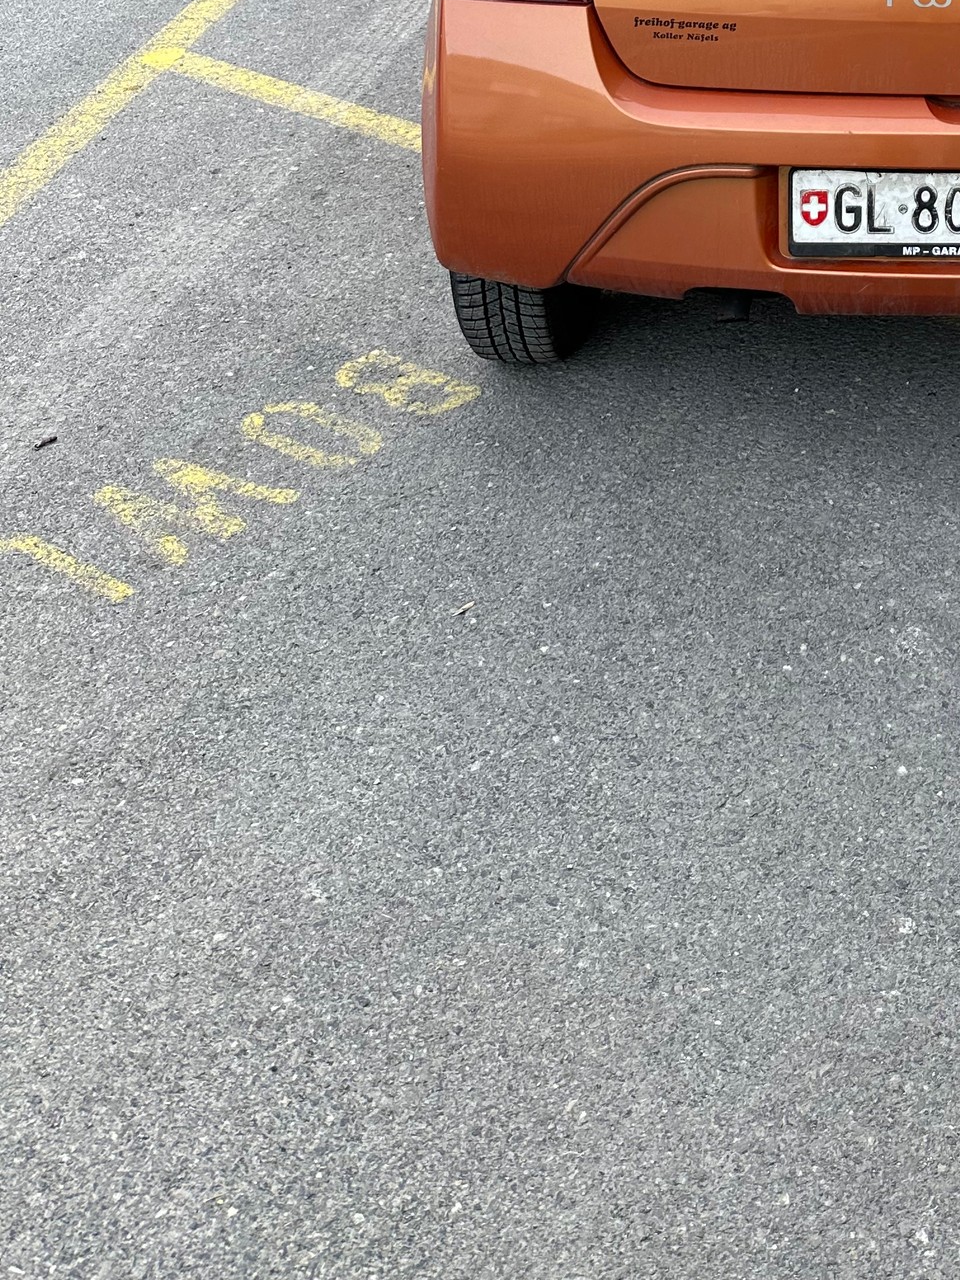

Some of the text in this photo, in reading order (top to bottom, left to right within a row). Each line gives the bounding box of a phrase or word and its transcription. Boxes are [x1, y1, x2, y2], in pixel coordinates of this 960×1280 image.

[722, 23, 736, 31] ag
[687, 33, 719, 42] Näfels
[902, 246, 920, 256] MP
